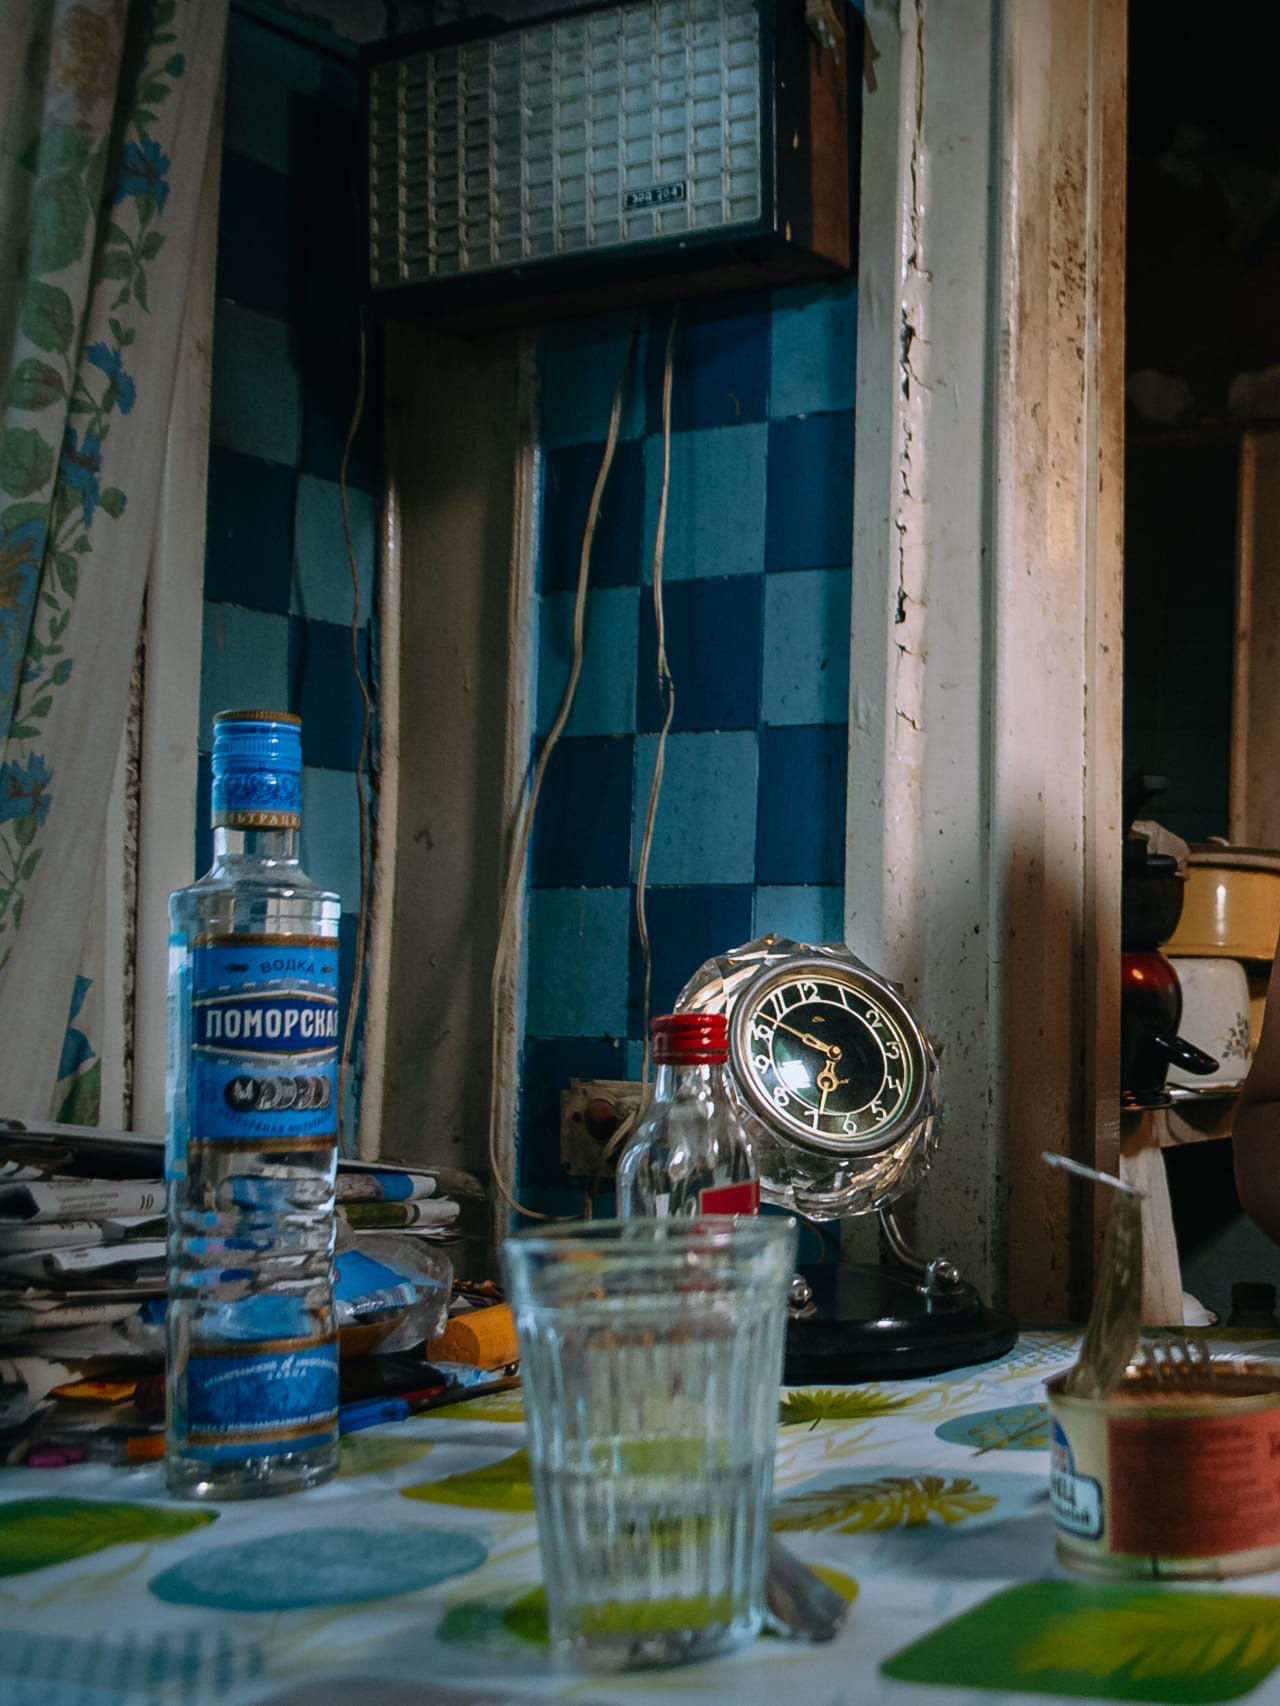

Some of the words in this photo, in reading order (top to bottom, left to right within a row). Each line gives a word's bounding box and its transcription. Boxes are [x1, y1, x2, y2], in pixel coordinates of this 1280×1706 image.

[259, 958, 315, 974] ВОДКА
[796, 981, 821, 1002] 12
[770, 990, 787, 1019] 11
[865, 1010, 883, 1028] 2
[752, 1020, 773, 1040] 10
[886, 1041, 900, 1059] 3
[754, 1054, 770, 1074] 9
[886, 1075, 903, 1096] 4
[773, 1086, 790, 1107] 8
[804, 1109, 819, 1130] 7
[871, 1100, 888, 1122] 5
[842, 1114, 858, 1135] 6
